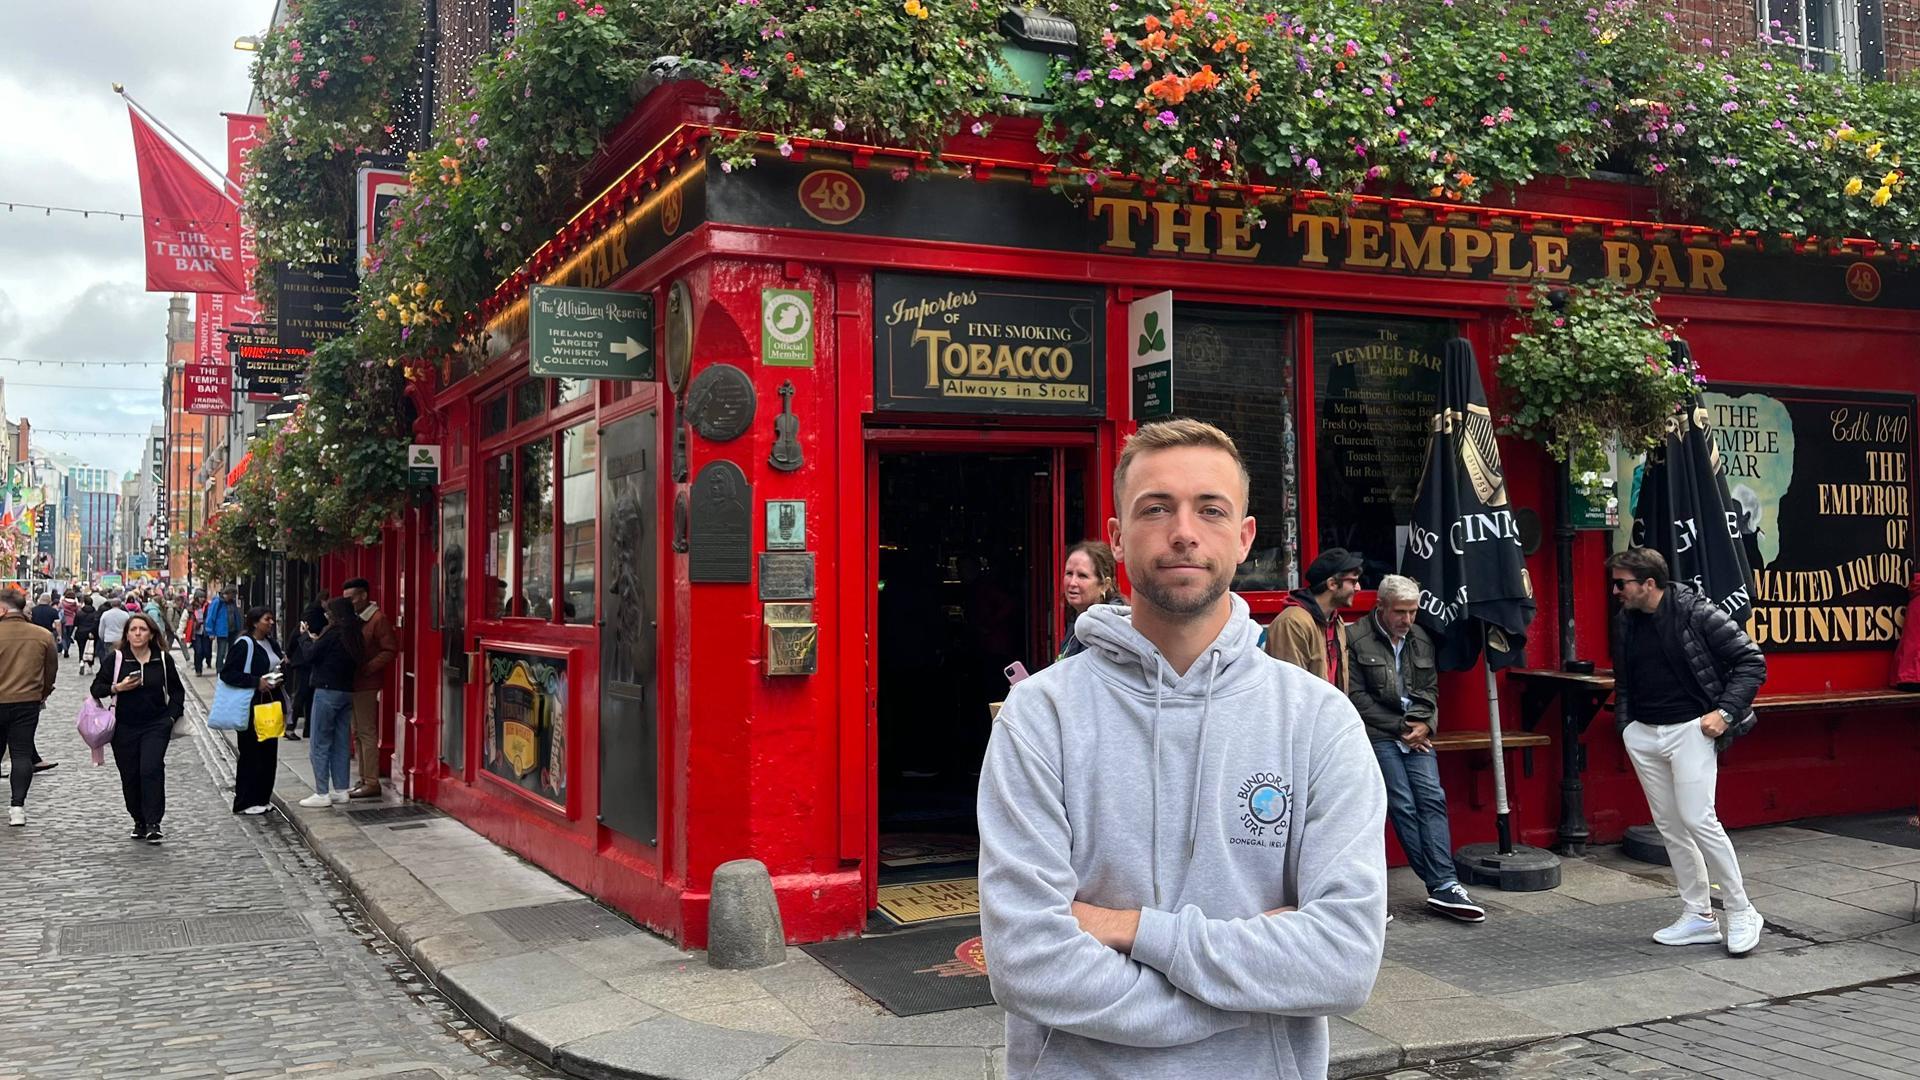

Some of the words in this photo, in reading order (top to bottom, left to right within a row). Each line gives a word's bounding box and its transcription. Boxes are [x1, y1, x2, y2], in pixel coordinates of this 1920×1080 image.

[811, 177, 851, 211] 48
[178, 231, 208, 244] THE
[152, 240, 234, 261] TEMPLE
[1090, 197, 1262, 260] THE
[1290, 213, 1573, 282] TEMPLE
[1602, 239, 1729, 293] BAR
[175, 258, 217, 272] BAR
[1851, 269, 1873, 292] 48
[283, 283, 310, 292] BEER
[212, 294, 223, 312] HE
[538, 301, 554, 313] The
[553, 296, 605, 321] Whiskey
[606, 303, 648, 323] Reserve
[885, 290, 978, 328] Importers
[286, 319, 313, 327] LIVE
[944, 313, 960, 324] OF
[301, 331, 335, 340] DAILY
[549, 329, 604, 339] IRELAND'S
[968, 323, 1001, 338] FINE
[1005, 326, 1073, 341] SMOKING
[1377, 329, 1399, 341] The
[233, 335, 252, 343] THE
[553, 338, 600, 348] LARGEST
[552, 347, 600, 357] WHISKEY
[773, 342, 803, 351] Official
[771, 350, 806, 359] Member
[911, 328, 1074, 389] TOBACCO
[1332, 344, 1404, 368] TEMPLE
[1408, 349, 1443, 373] BAR
[246, 362, 301, 372] DISTILLERY
[543, 356, 609, 367] COLLECTION
[200, 366, 218, 375] THE
[189, 375, 228, 385] TEMPLE
[258, 376, 288, 384] STORE
[197, 384, 218, 393] BAR
[946, 379, 1007, 397] Always
[1016, 384, 1031, 397] in
[1039, 383, 1086, 399] Stock
[1334, 403, 1357, 415] Meat
[1714, 404, 1759, 429] THE
[1322, 418, 1347, 430] Fresh
[1875, 415, 1908, 443] 1840
[1712, 428, 1780, 454] EMPLE
[1347, 451, 1381, 462] Toasted
[1345, 467, 1361, 477] Hot
[1866, 451, 1906, 482] THE
[1473, 472, 1488, 494] 1759
[1818, 484, 1909, 516] EMPEROR
[1886, 520, 1908, 550] OF
[1754, 568, 1833, 603] MALTED
[1835, 552, 1914, 597] LIQUORS
[1746, 605, 1908, 645] GUINNESS
[1237, 772, 1294, 803] BUNDORA
[1240, 813, 1265, 837] SURF
[911, 882, 965, 895] THE
[934, 900, 980, 912] BA
